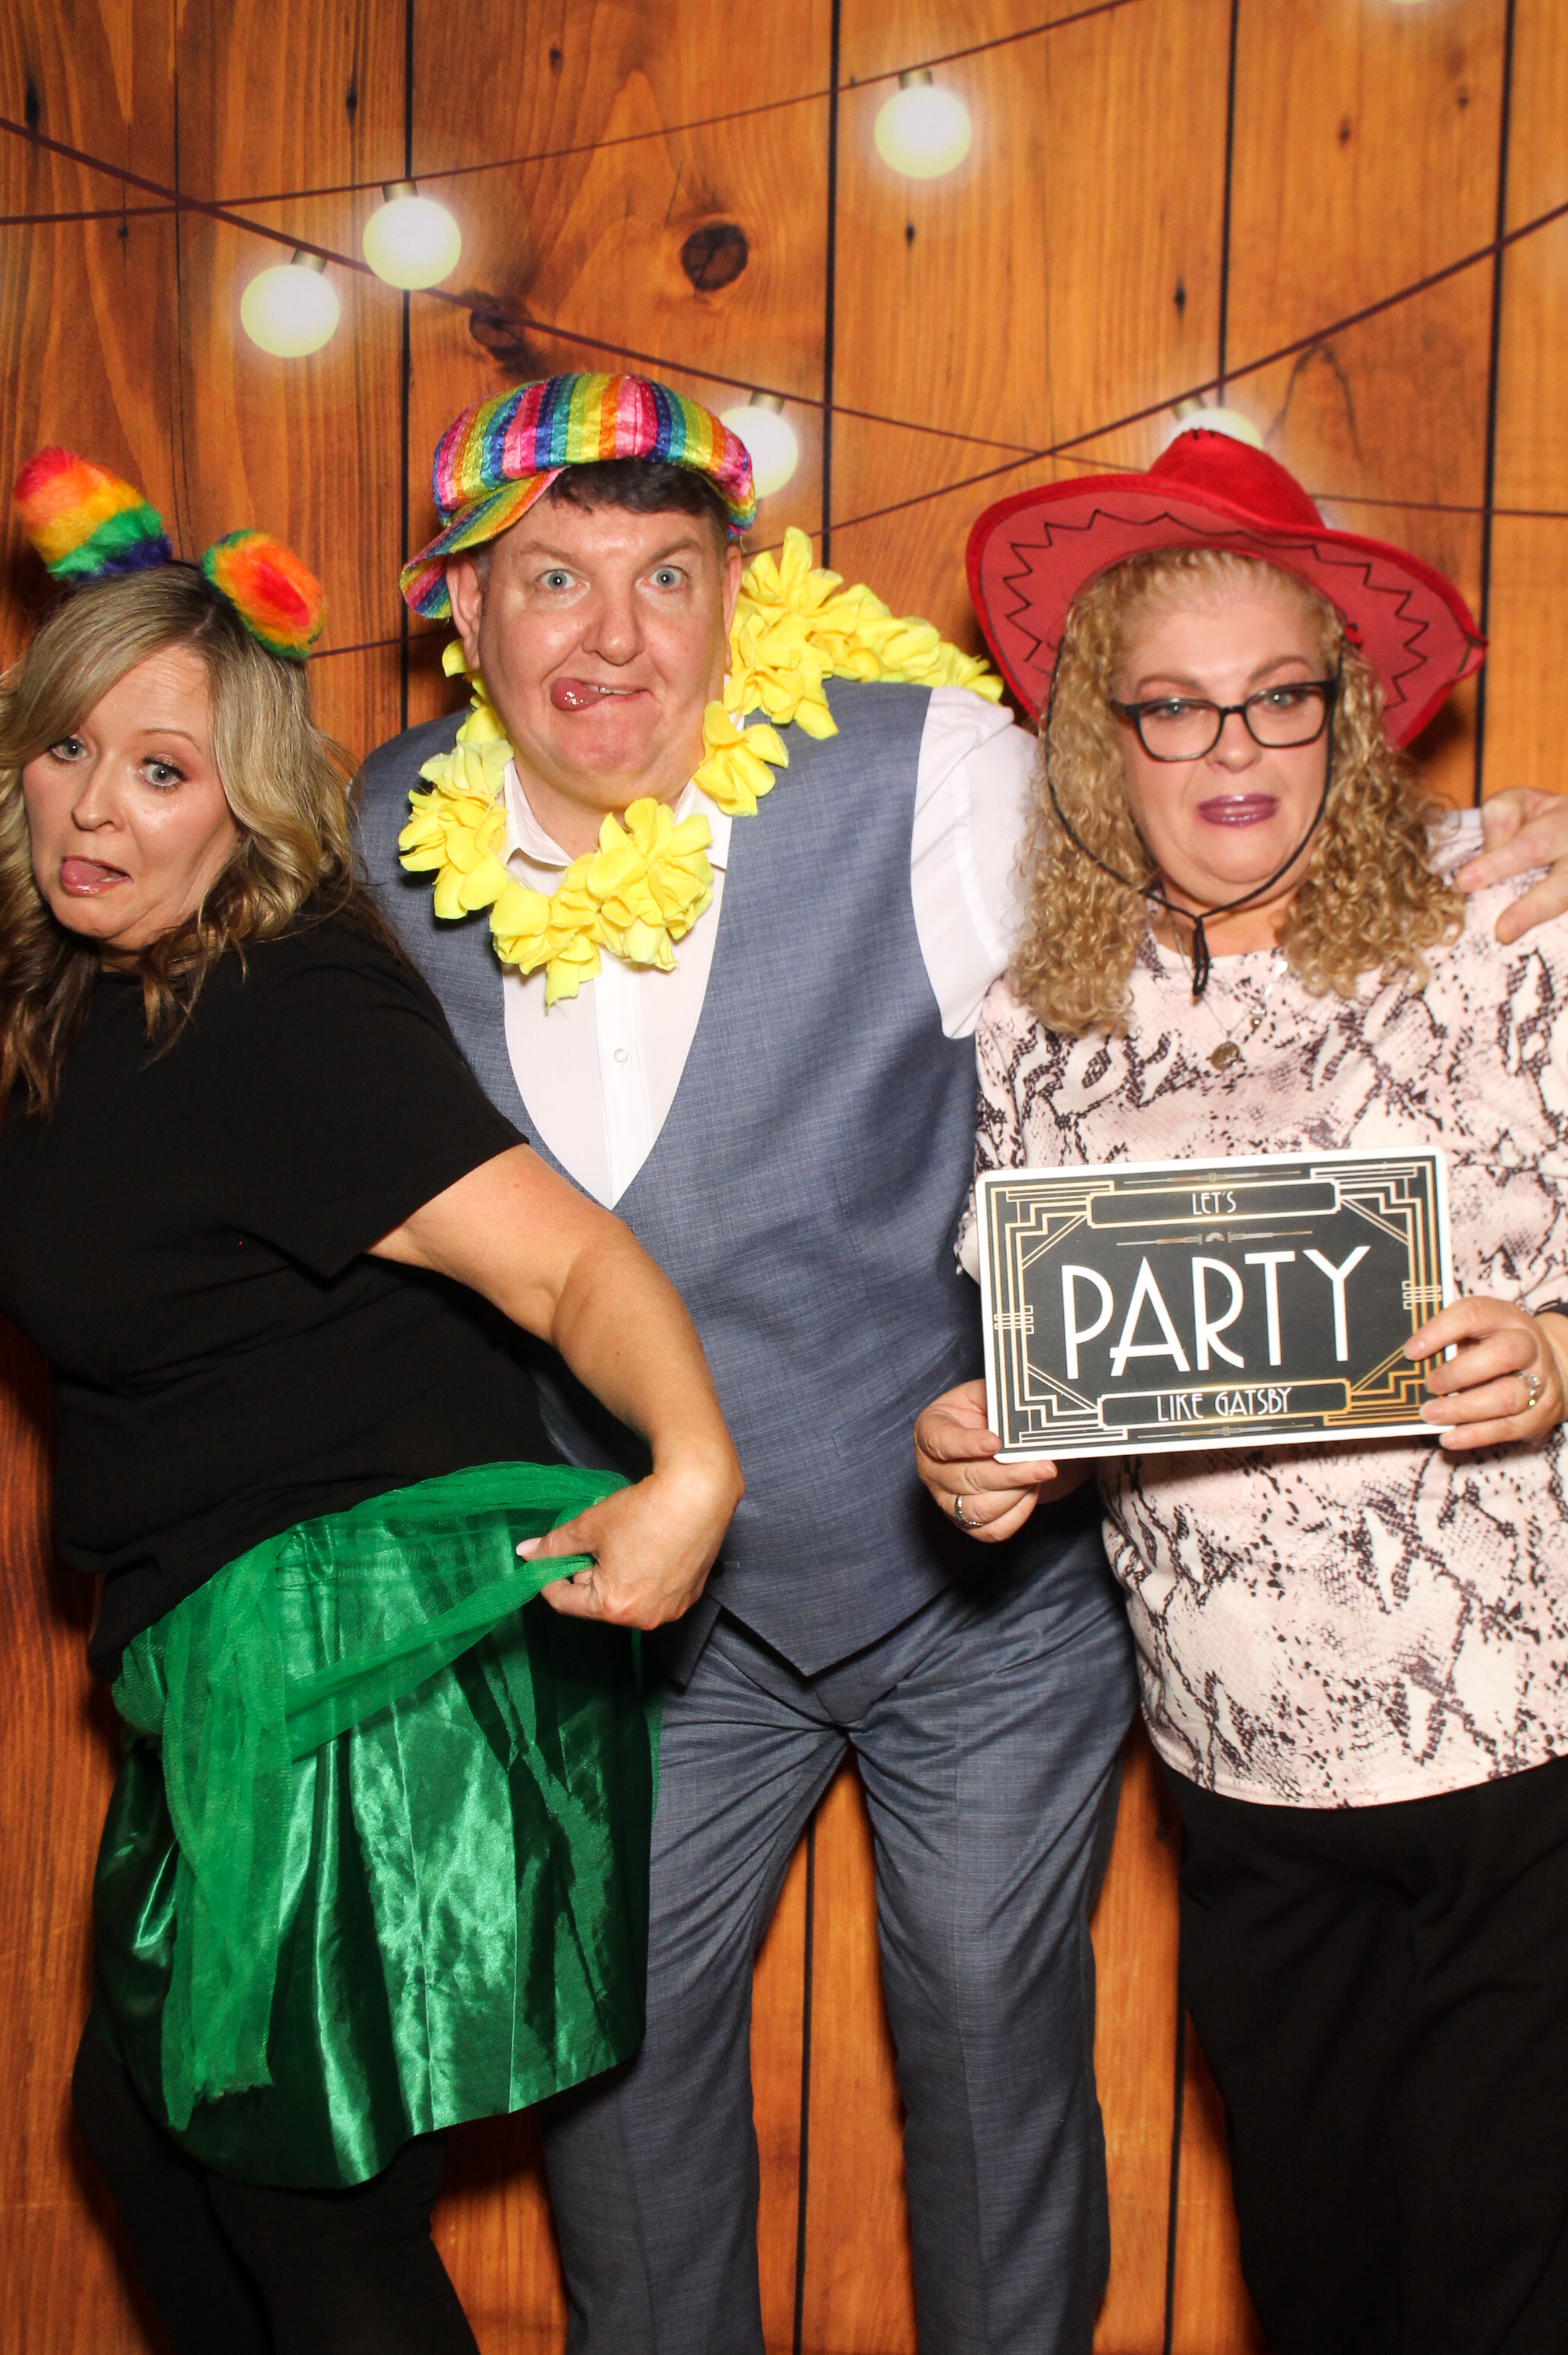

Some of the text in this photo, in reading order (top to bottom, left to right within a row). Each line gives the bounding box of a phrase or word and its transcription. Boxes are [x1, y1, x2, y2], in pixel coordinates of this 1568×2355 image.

[1192, 1190, 1237, 1216] LET'S
[1061, 1245, 1371, 1380] PARTY
[1156, 1386, 1293, 1423] LIKE GATSBY
